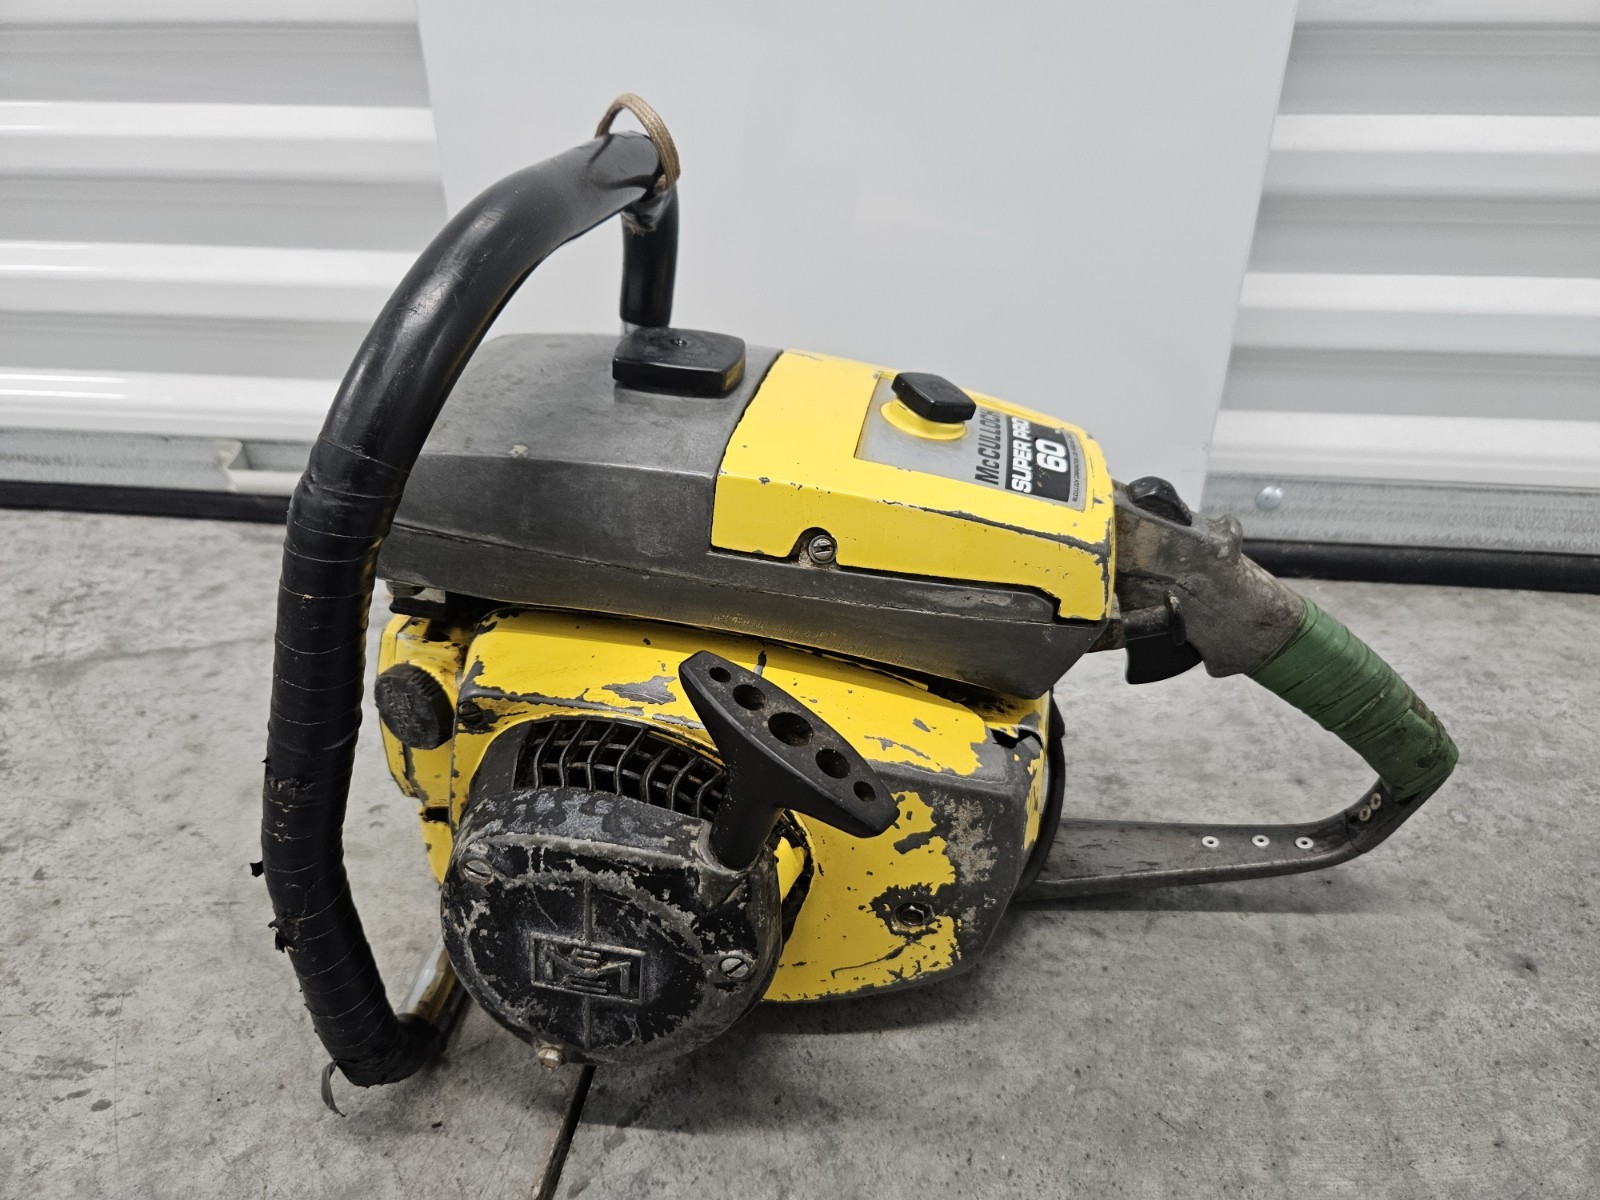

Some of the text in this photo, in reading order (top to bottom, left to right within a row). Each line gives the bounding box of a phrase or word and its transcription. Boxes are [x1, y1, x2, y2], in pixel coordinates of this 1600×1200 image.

[975, 408, 1001, 485] McCULLOCH
[1011, 417, 1033, 493] SUPER PRO
[1035, 438, 1068, 473] 60
